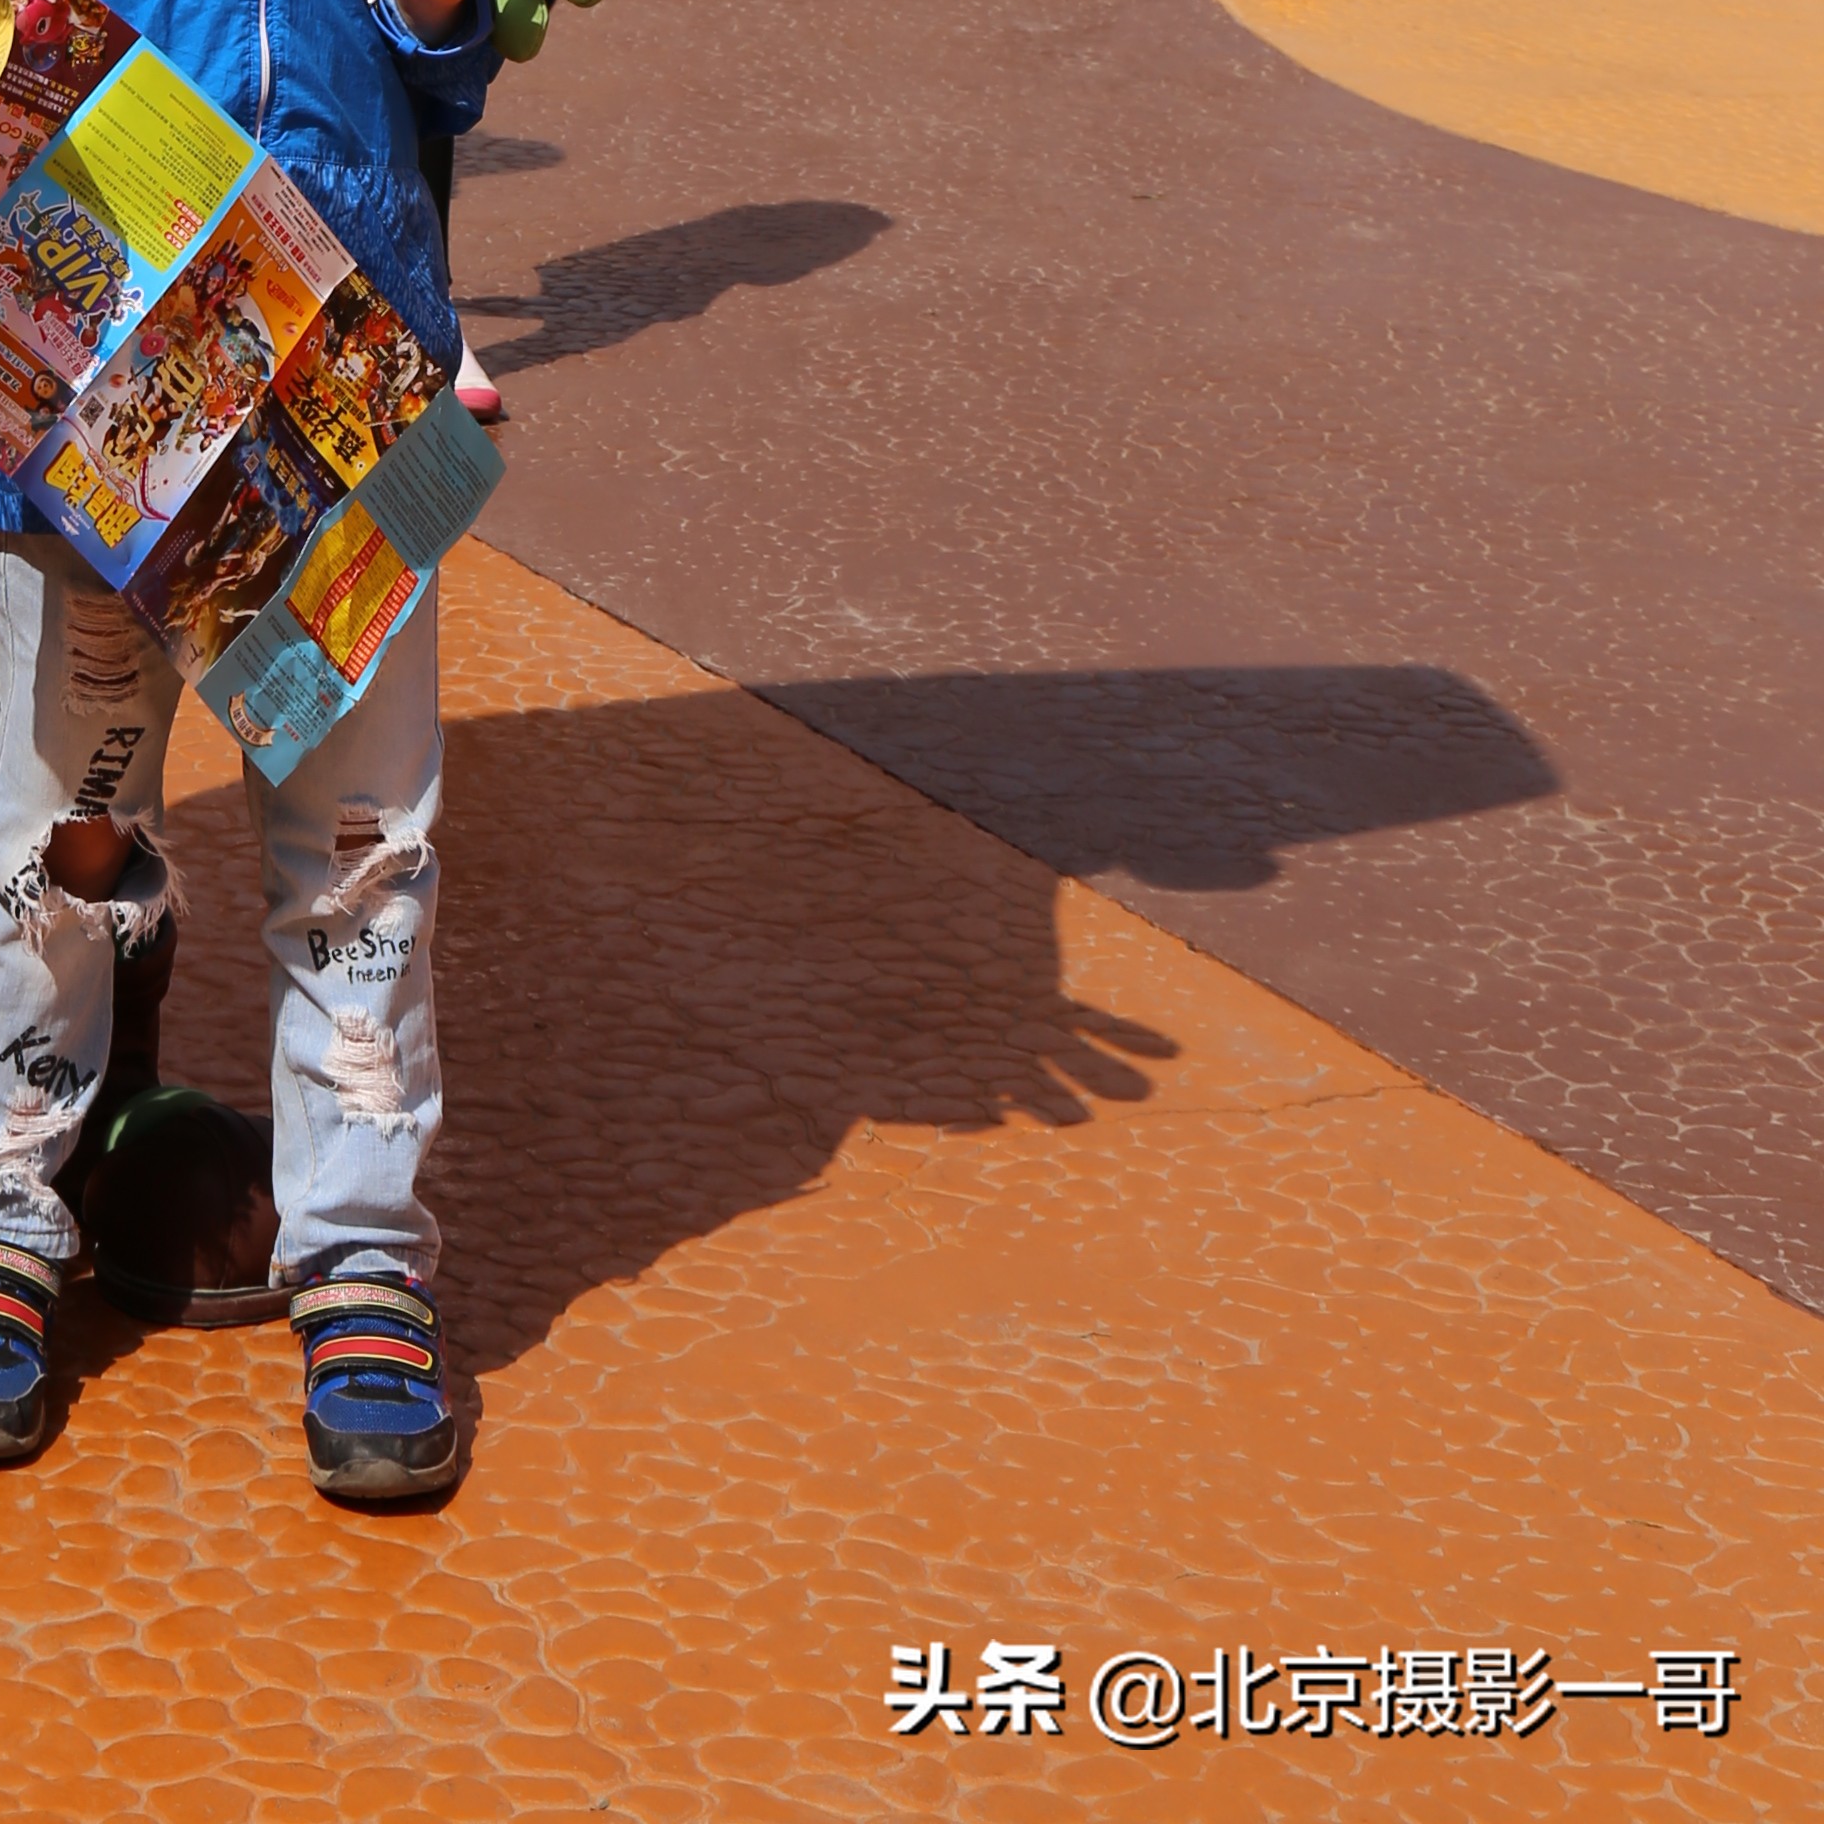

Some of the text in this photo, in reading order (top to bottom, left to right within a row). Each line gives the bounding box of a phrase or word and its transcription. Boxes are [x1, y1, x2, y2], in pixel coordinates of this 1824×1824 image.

[33, 238, 112, 310] VIP
[41, 439, 142, 548] 甜品王国
